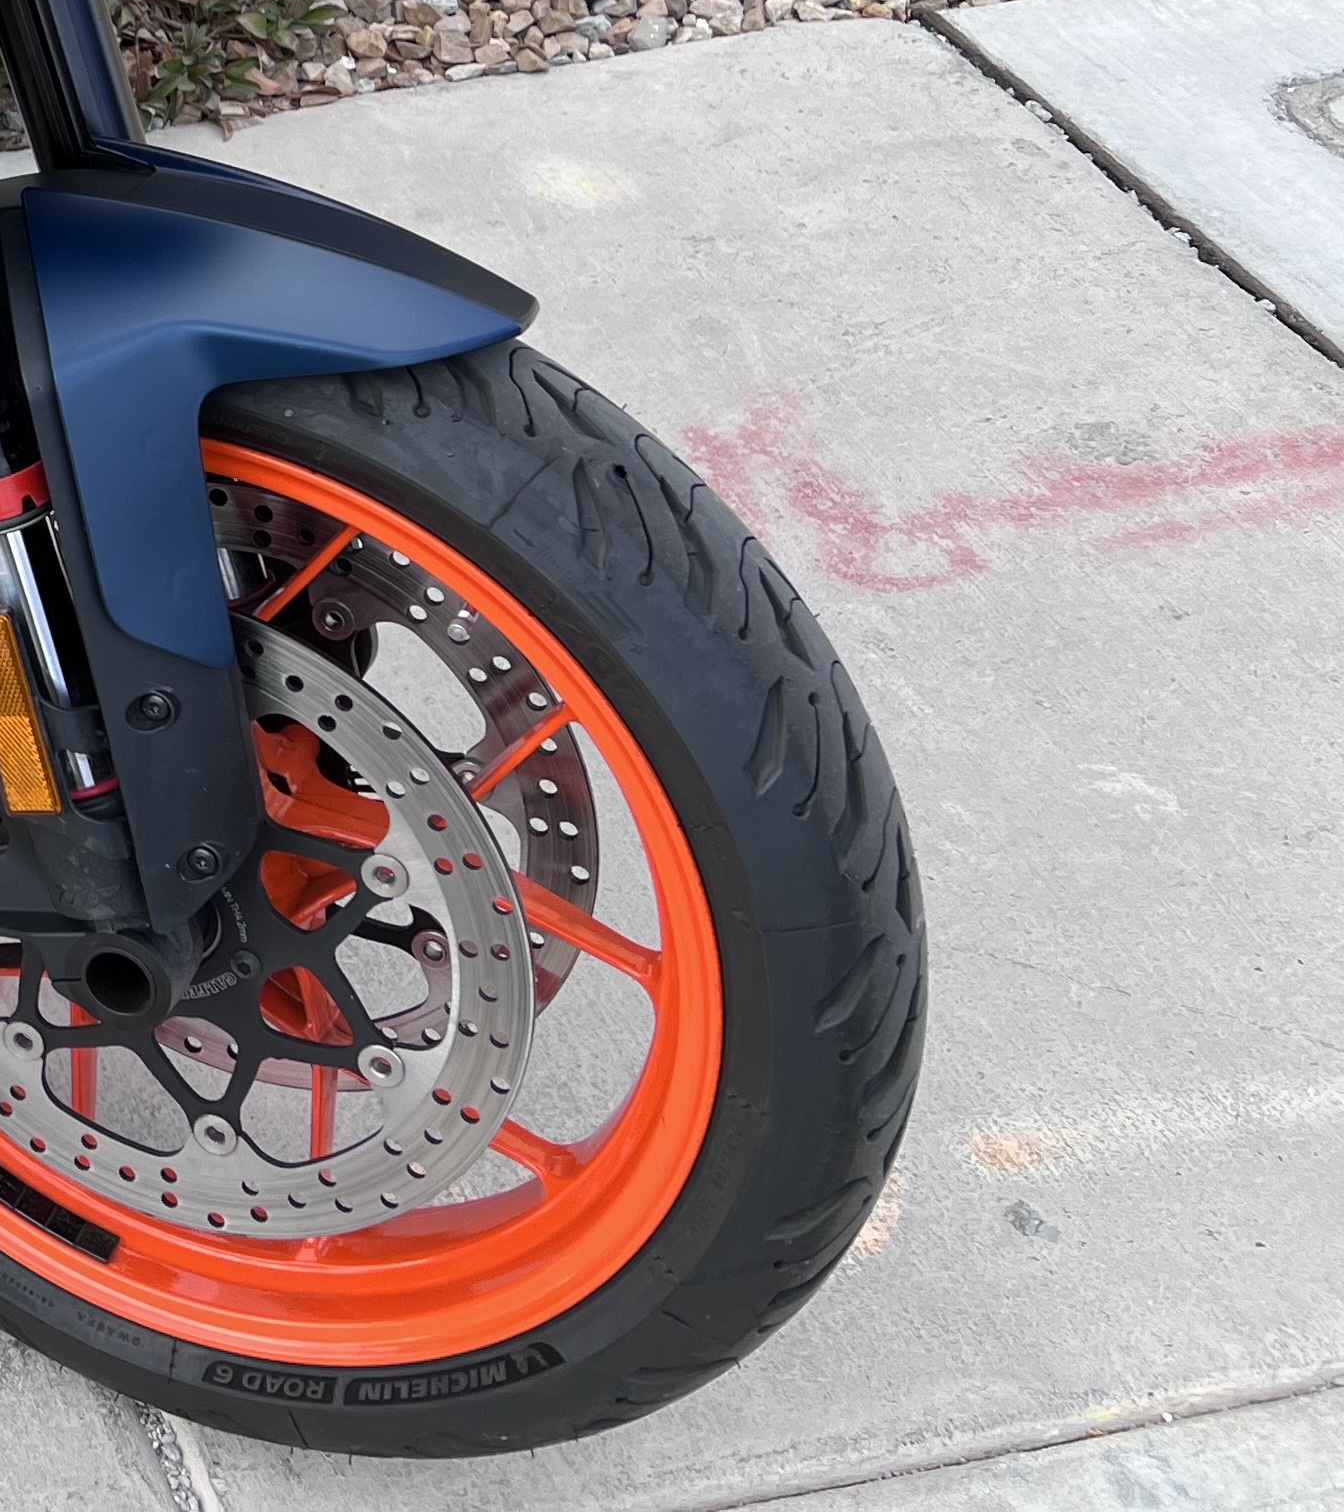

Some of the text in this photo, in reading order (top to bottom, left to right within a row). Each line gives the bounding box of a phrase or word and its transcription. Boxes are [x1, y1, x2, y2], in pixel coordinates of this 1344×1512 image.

[212, 1364, 326, 1400] ROAD 6
[357, 1359, 508, 1402] MICHELIN
